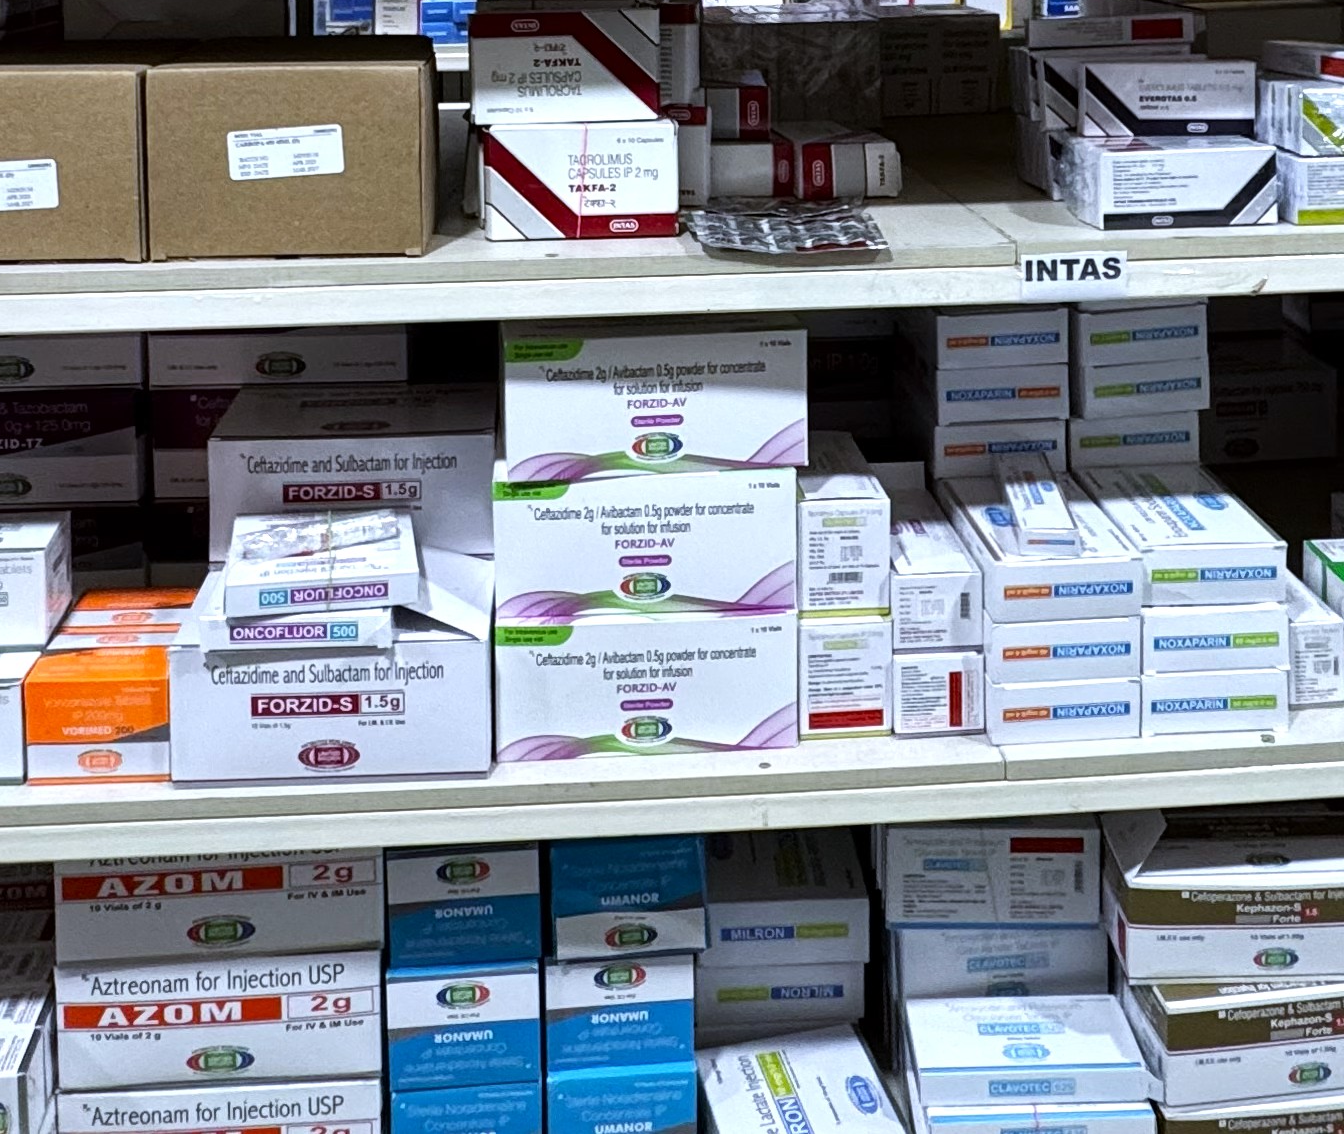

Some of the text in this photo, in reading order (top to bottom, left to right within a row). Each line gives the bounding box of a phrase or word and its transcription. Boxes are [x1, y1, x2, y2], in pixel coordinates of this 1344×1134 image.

[518, 85, 582, 97] TACROLIMUS
[1138, 94, 1198, 104] EVEROTAS 0.5
[568, 154, 632, 165] TACROLIMUS
[568, 167, 658, 180] CAPSULES IP 2 mg
[568, 184, 616, 192] TAKFA-2
[1025, 258, 1122, 282] INTAS
[627, 398, 686, 410] FORZID-AV
[247, 453, 457, 473] Ceftazidime and Sulbactam for Injection
[288, 484, 418, 499] FORZID-S 1.5g
[615, 538, 675, 549] FORZID-AV
[1205, 568, 1272, 579] NOXAPARIN
[261, 586, 385, 604] ONCOFLUOR 500
[1059, 584, 1128, 595] NOXAPARIN
[233, 626, 356, 639] ONCOFLUOR 500
[1159, 638, 1227, 649] NOXAPARIN
[1056, 645, 1126, 657] NOXAPARIN
[211, 663, 444, 685] Ceftazidime and Sulbactam for Injection
[603, 666, 692, 680] for solution for infusion
[616, 682, 676, 693] FORZID-AV
[257, 694, 401, 714] FORZID-S 1.5g
[1156, 700, 1225, 712] NOXAPARIN
[1056, 705, 1125, 717] NOXAPARIN
[97, 864, 353, 898] AZOM 2g
[600, 893, 659, 906] UMANOR
[435, 906, 493, 919] UMANOR
[1236, 904, 1301, 914] Kephazon-S
[1272, 915, 1300, 923] Forte
[730, 926, 786, 940] MILRON
[90, 963, 345, 996] Aztreonam for Injection USP
[97, 995, 351, 1027] AZOM 2g
[591, 1010, 648, 1024] UMANOR
[1270, 1014, 1332, 1028] Kephazon-S
[434, 1030, 493, 1043] UMANOR
[1306, 1026, 1332, 1036] Forte
[91, 1095, 344, 1127] Aztreonam for Injection USP
